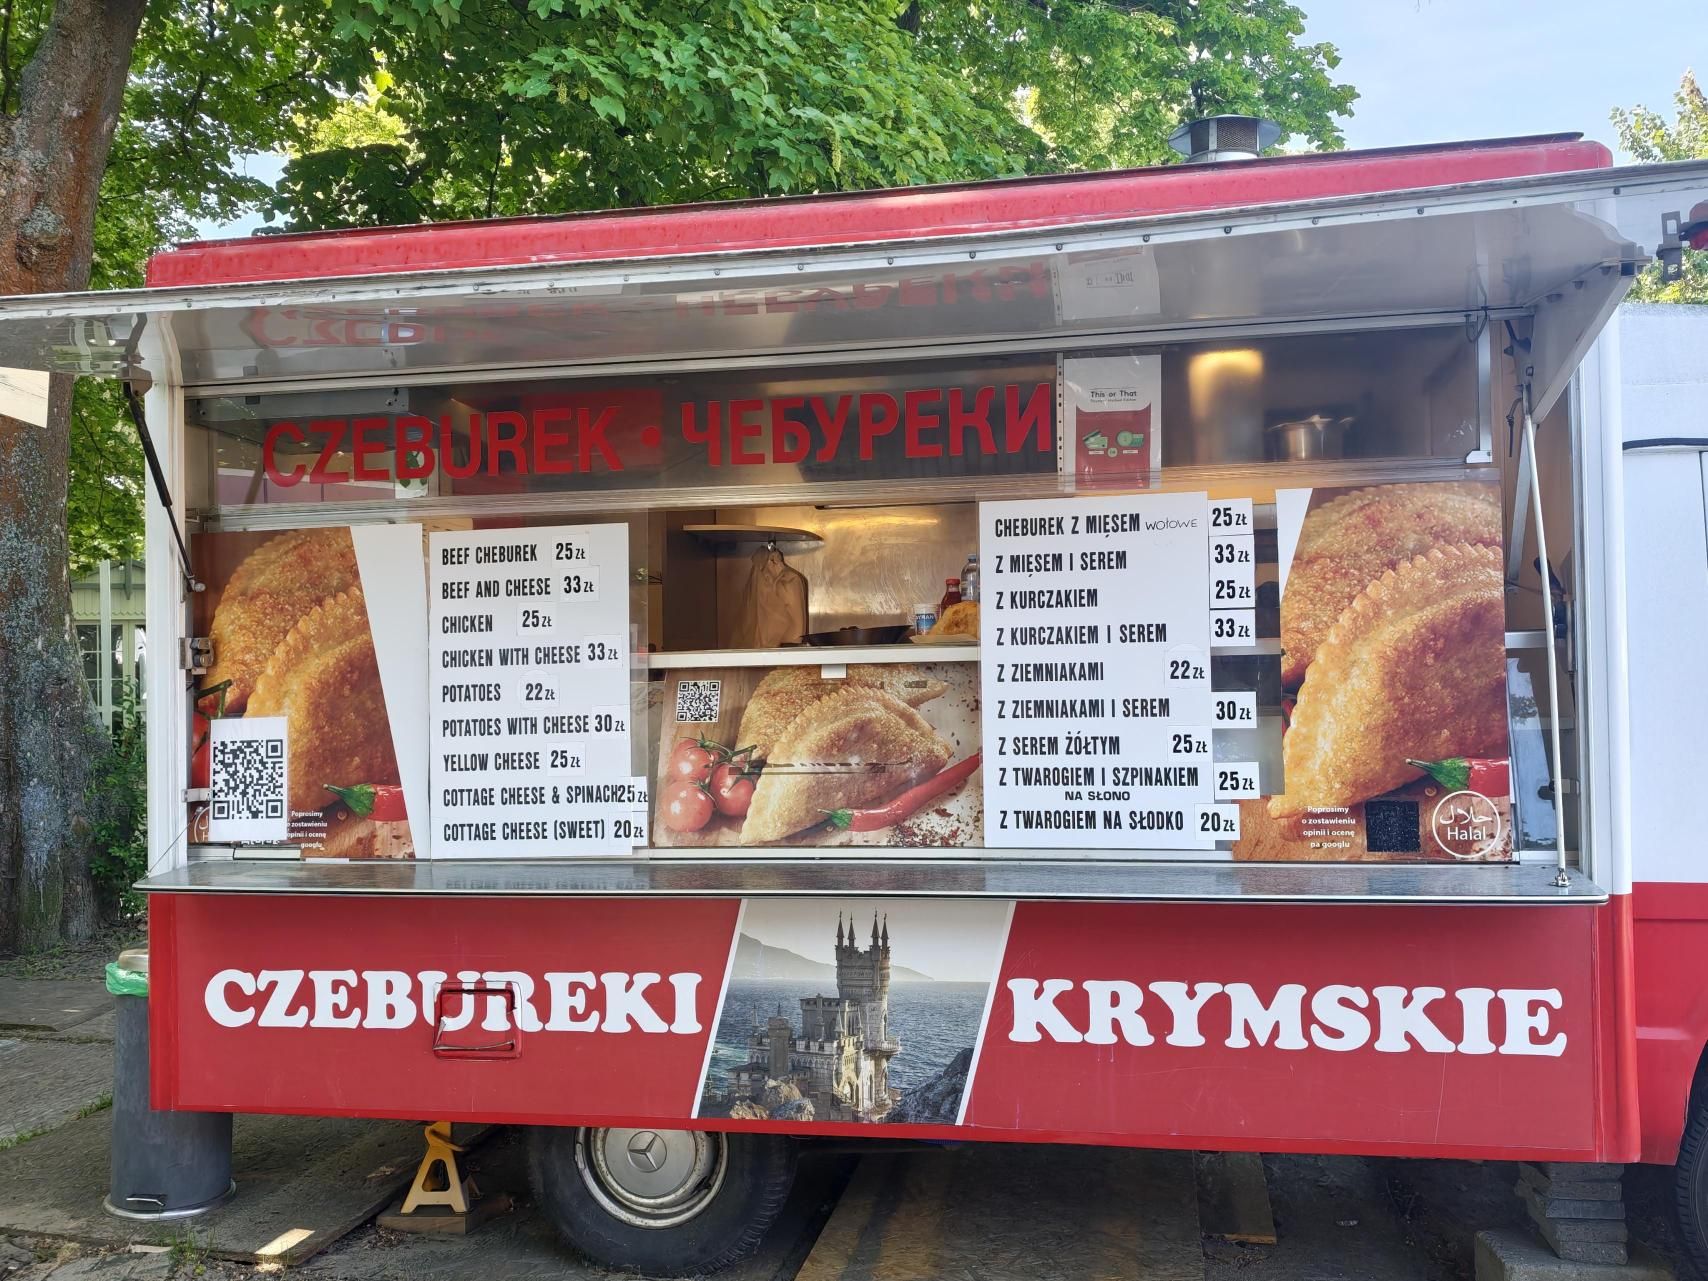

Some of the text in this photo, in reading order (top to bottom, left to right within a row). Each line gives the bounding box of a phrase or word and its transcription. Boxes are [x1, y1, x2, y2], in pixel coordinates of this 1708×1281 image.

[681, 383, 1052, 467] ЧЕБУРЕКИ
[263, 405, 624, 488] CZEBUREK
[995, 513, 1140, 538] CHEBUREK Z MIĘSEM
[442, 544, 537, 565] BEEF CHEBUREK
[995, 550, 1127, 577] Z MIĘSEM I SEREM
[442, 578, 550, 599] BEEF AND CHEESE
[996, 588, 1098, 609] Z KURCZAKIEM
[442, 615, 492, 633] CHICKEN
[997, 623, 1167, 645] Z KURCZAKIEM I SEREM
[442, 646, 580, 668] CHICKEN WITH CHEESE
[997, 661, 1104, 682] Z ZIEMNIAKAMI
[442, 684, 500, 702] POTATOES
[998, 698, 1170, 719] Z ZIEMNIAKAMI I SEREM
[442, 715, 589, 737] POTATOES WITH CHEESE
[998, 731, 1120, 756] Z SEREM ŻÓŁTYM
[444, 752, 540, 772] YELLOW CHEESE
[999, 767, 1199, 787] Z TWAROGIEM I SZPINAKIEM
[443, 784, 618, 806] COTTAGE CHEESE & SPINACH
[1064, 791, 1131, 801] NA SŁONO
[291, 810, 323, 819] Poprosimy
[1000, 810, 1184, 831] Z TWAROGIEM NA SŁODKO
[1307, 806, 1350, 814] Poprosimy
[1439, 804, 1493, 825] حلال
[444, 819, 605, 841] COTTAGE CHEESE (SWEET)
[1308, 817, 1356, 825] zostawieniu
[1447, 826, 1486, 841] Halal
[204, 969, 703, 1034] CZEBUREKI
[1007, 978, 1567, 1058] KRYMSKIE
